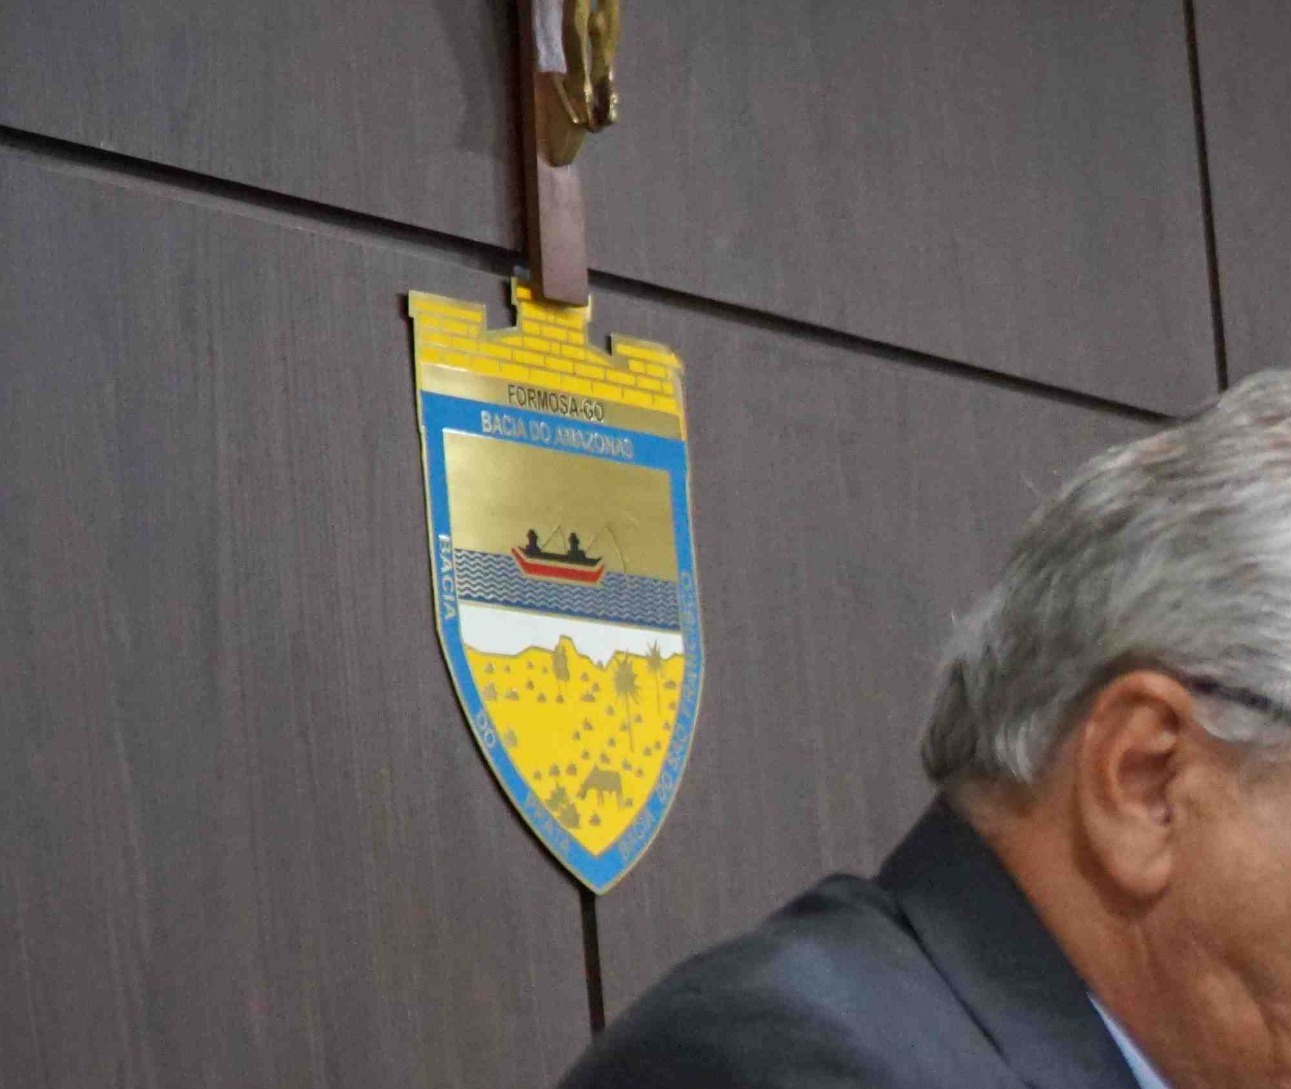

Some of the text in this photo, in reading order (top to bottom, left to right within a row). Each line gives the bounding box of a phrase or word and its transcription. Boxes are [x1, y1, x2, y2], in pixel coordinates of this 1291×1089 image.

[507, 384, 605, 421] FORMOSA-GO
[481, 410, 526, 437] BACIA
[438, 534, 456, 620] BACIA
